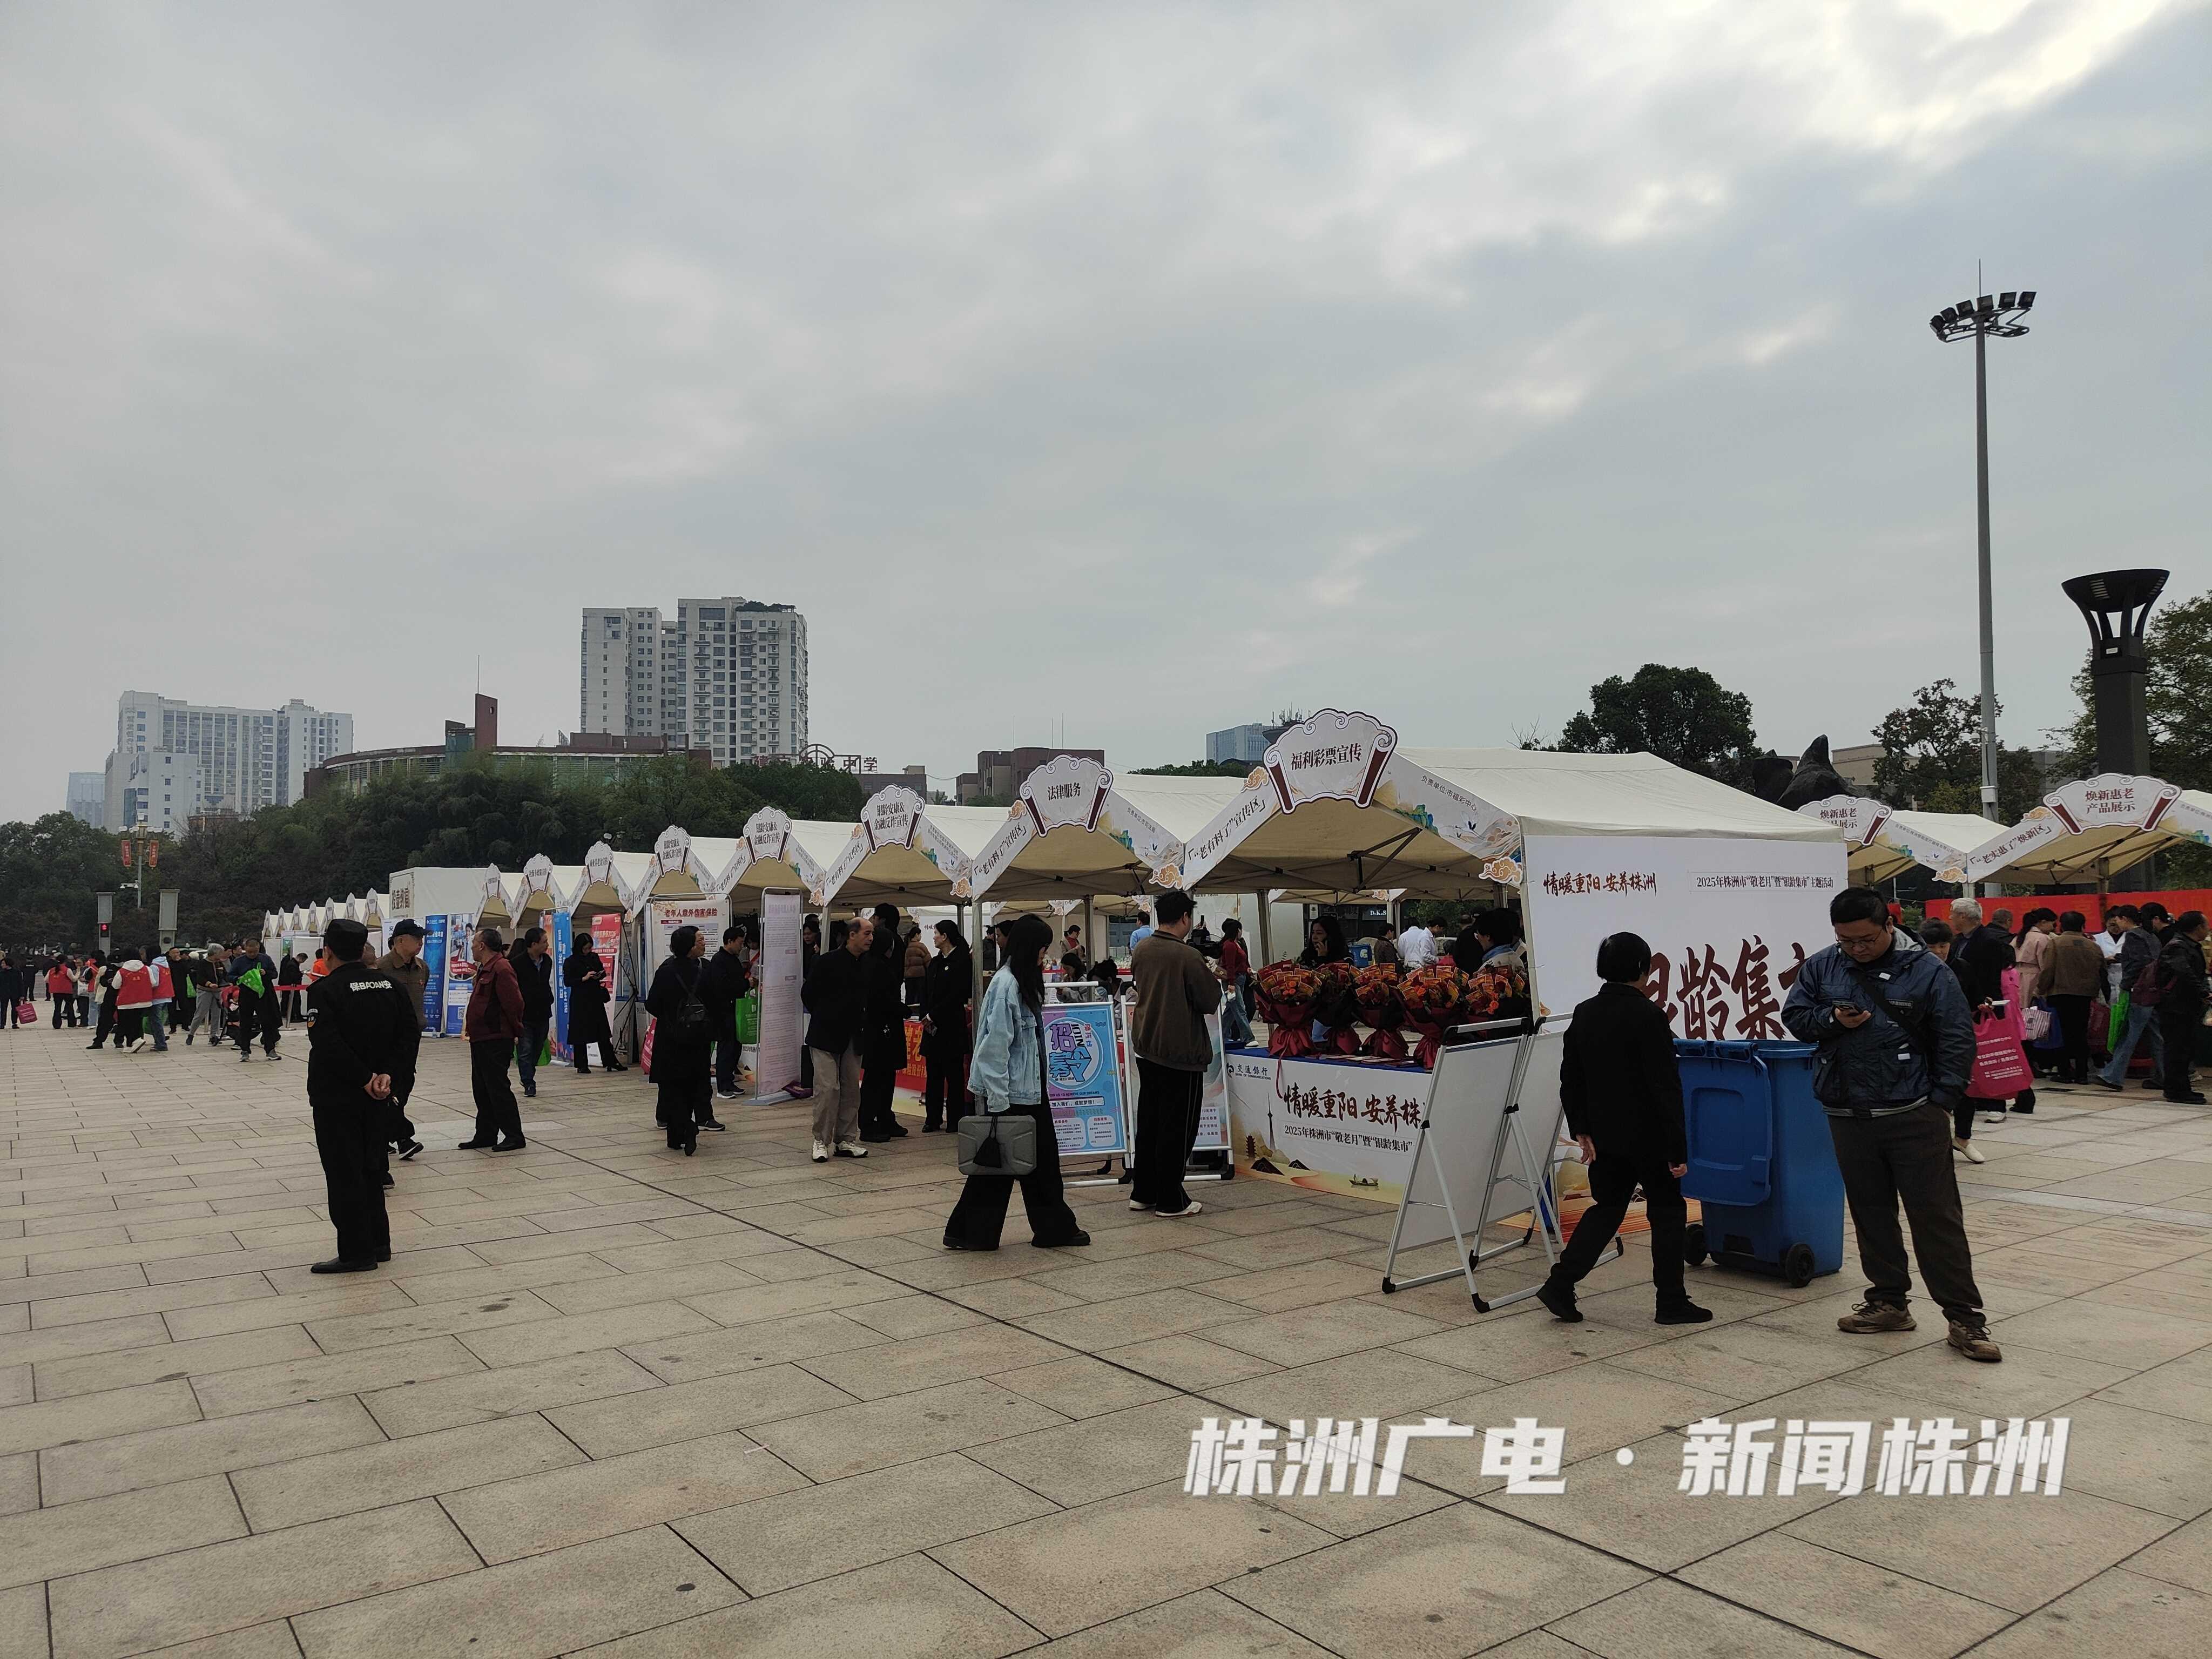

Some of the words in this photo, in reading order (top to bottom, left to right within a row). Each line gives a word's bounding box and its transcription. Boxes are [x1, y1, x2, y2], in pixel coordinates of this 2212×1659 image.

[1291, 743, 1362, 771] 福利彩票宣传
[1047, 781, 1082, 801] 法律服务
[2085, 787, 2135, 802] 焕新惠老
[1820, 807, 1857, 819] 焕新惠老
[2086, 801, 2136, 814] 产品展示
[874, 814, 909, 831] 金融反诈宣传
[754, 832, 780, 845] 金融反诈宣传
[1542, 870, 1601, 897] 情暖重阳
[1602, 871, 1657, 898] 安养株洲
[665, 908, 718, 918] 老年人意外伤害保险
[349, 980, 393, 992] 保BAOAN安
[1283, 1082, 1358, 1122] 情暖重阳
[1361, 1093, 1425, 1136] 安养株
[1284, 1125, 1414, 1153] 2025年株洲市“敬老月”暨“银龄集市”
